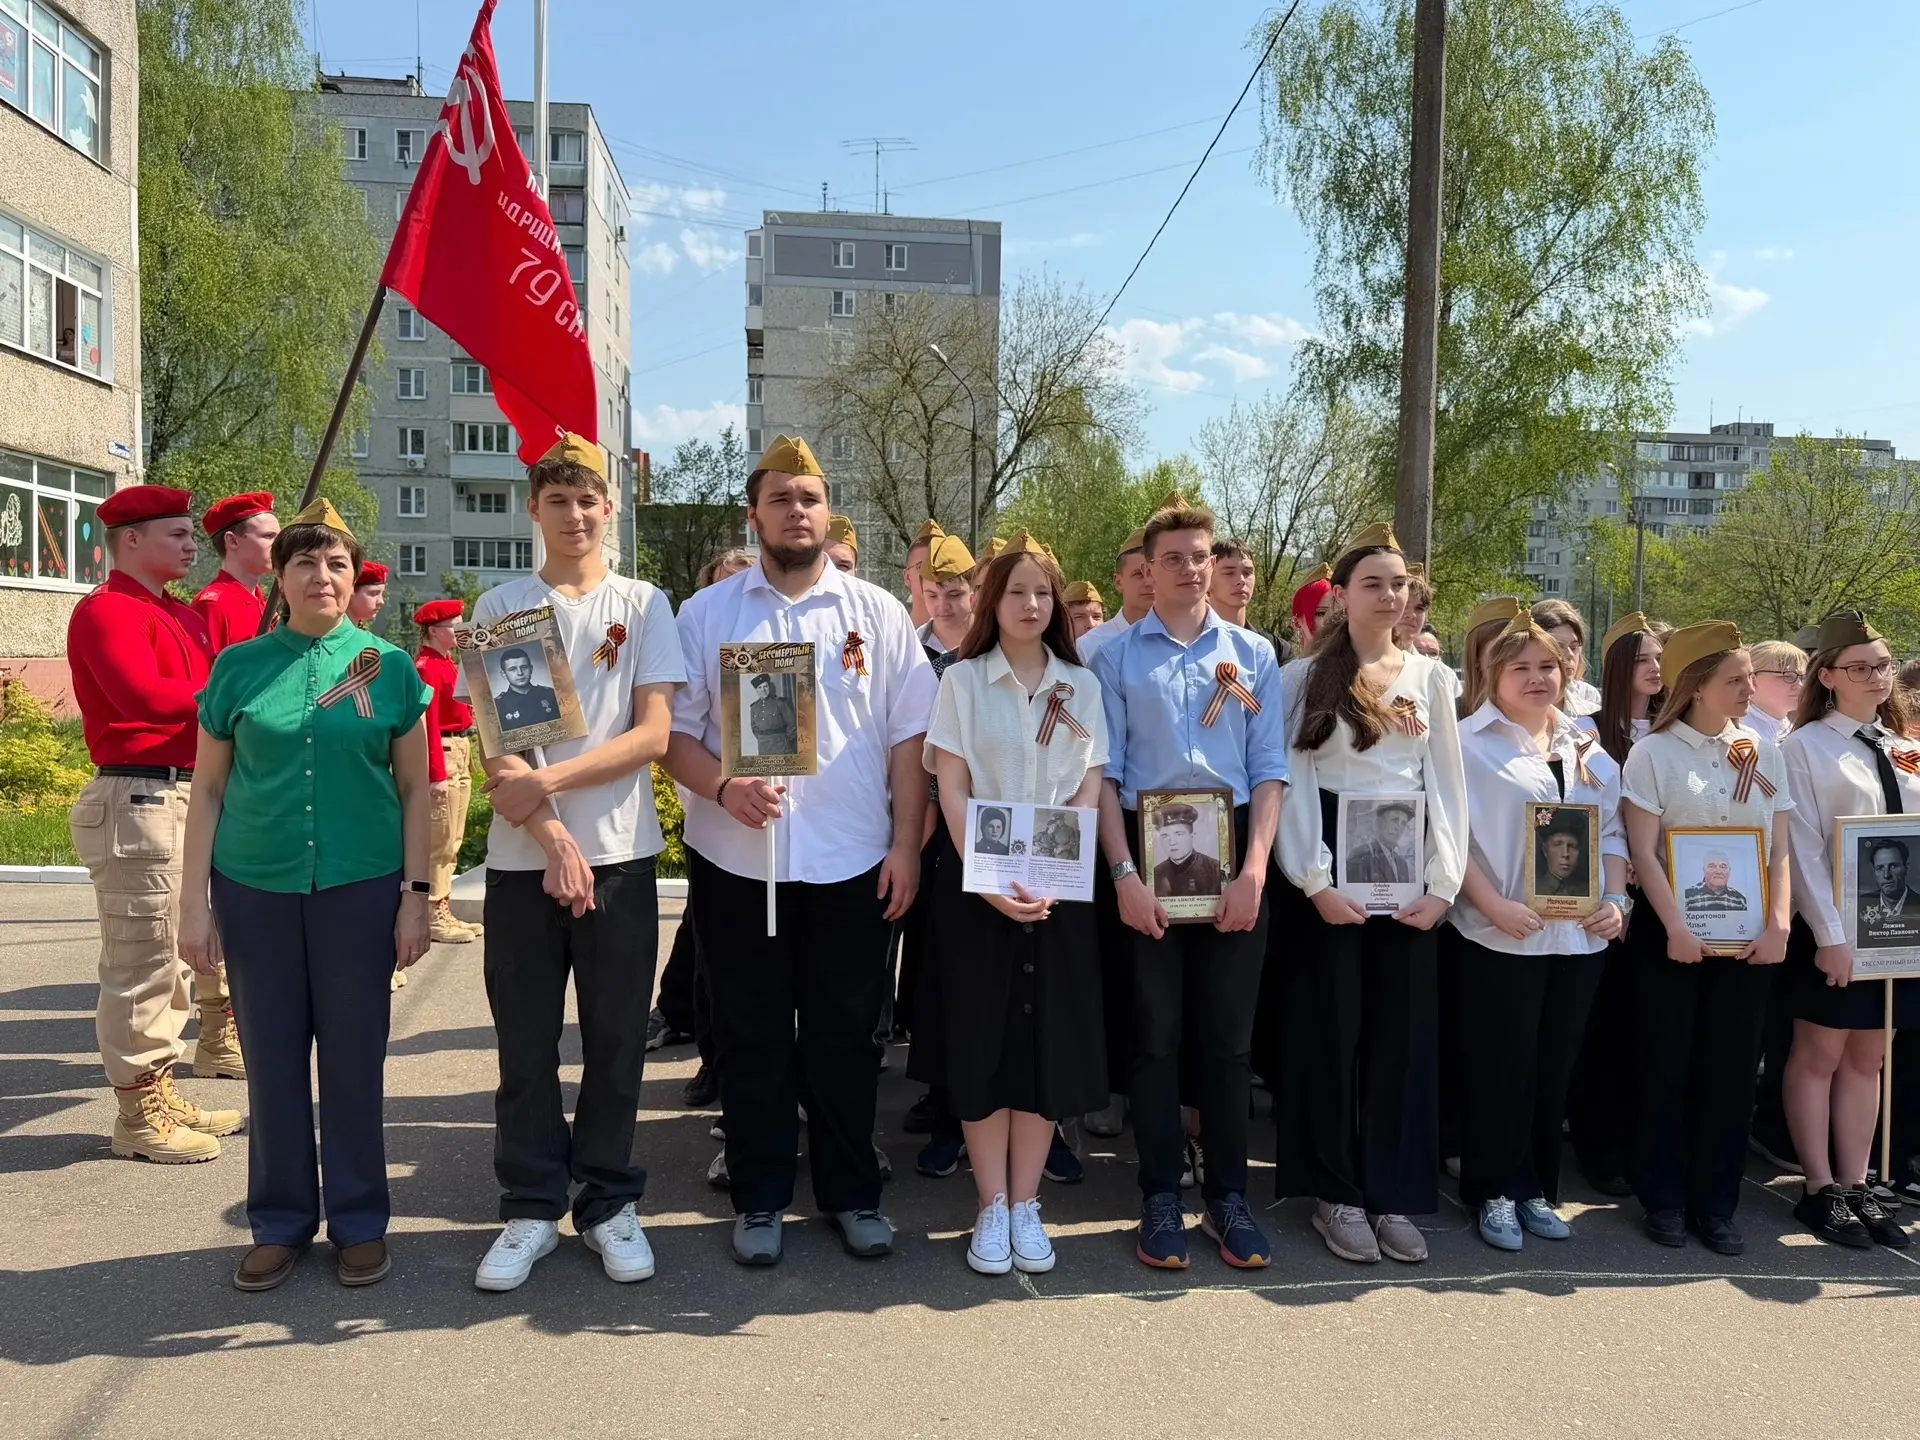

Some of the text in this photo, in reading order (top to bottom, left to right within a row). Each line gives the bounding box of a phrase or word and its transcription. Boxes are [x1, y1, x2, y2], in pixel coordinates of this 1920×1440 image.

[509, 247, 562, 306] 79
[496, 606, 550, 634] БЕССМЕРТНЫЙ
[515, 623, 536, 638] ПОЛК
[758, 643, 810, 660] БЕССМЕРТНЫЙ
[774, 657, 794, 668] ПОЛК
[1685, 912, 1726, 920] Харитонов
